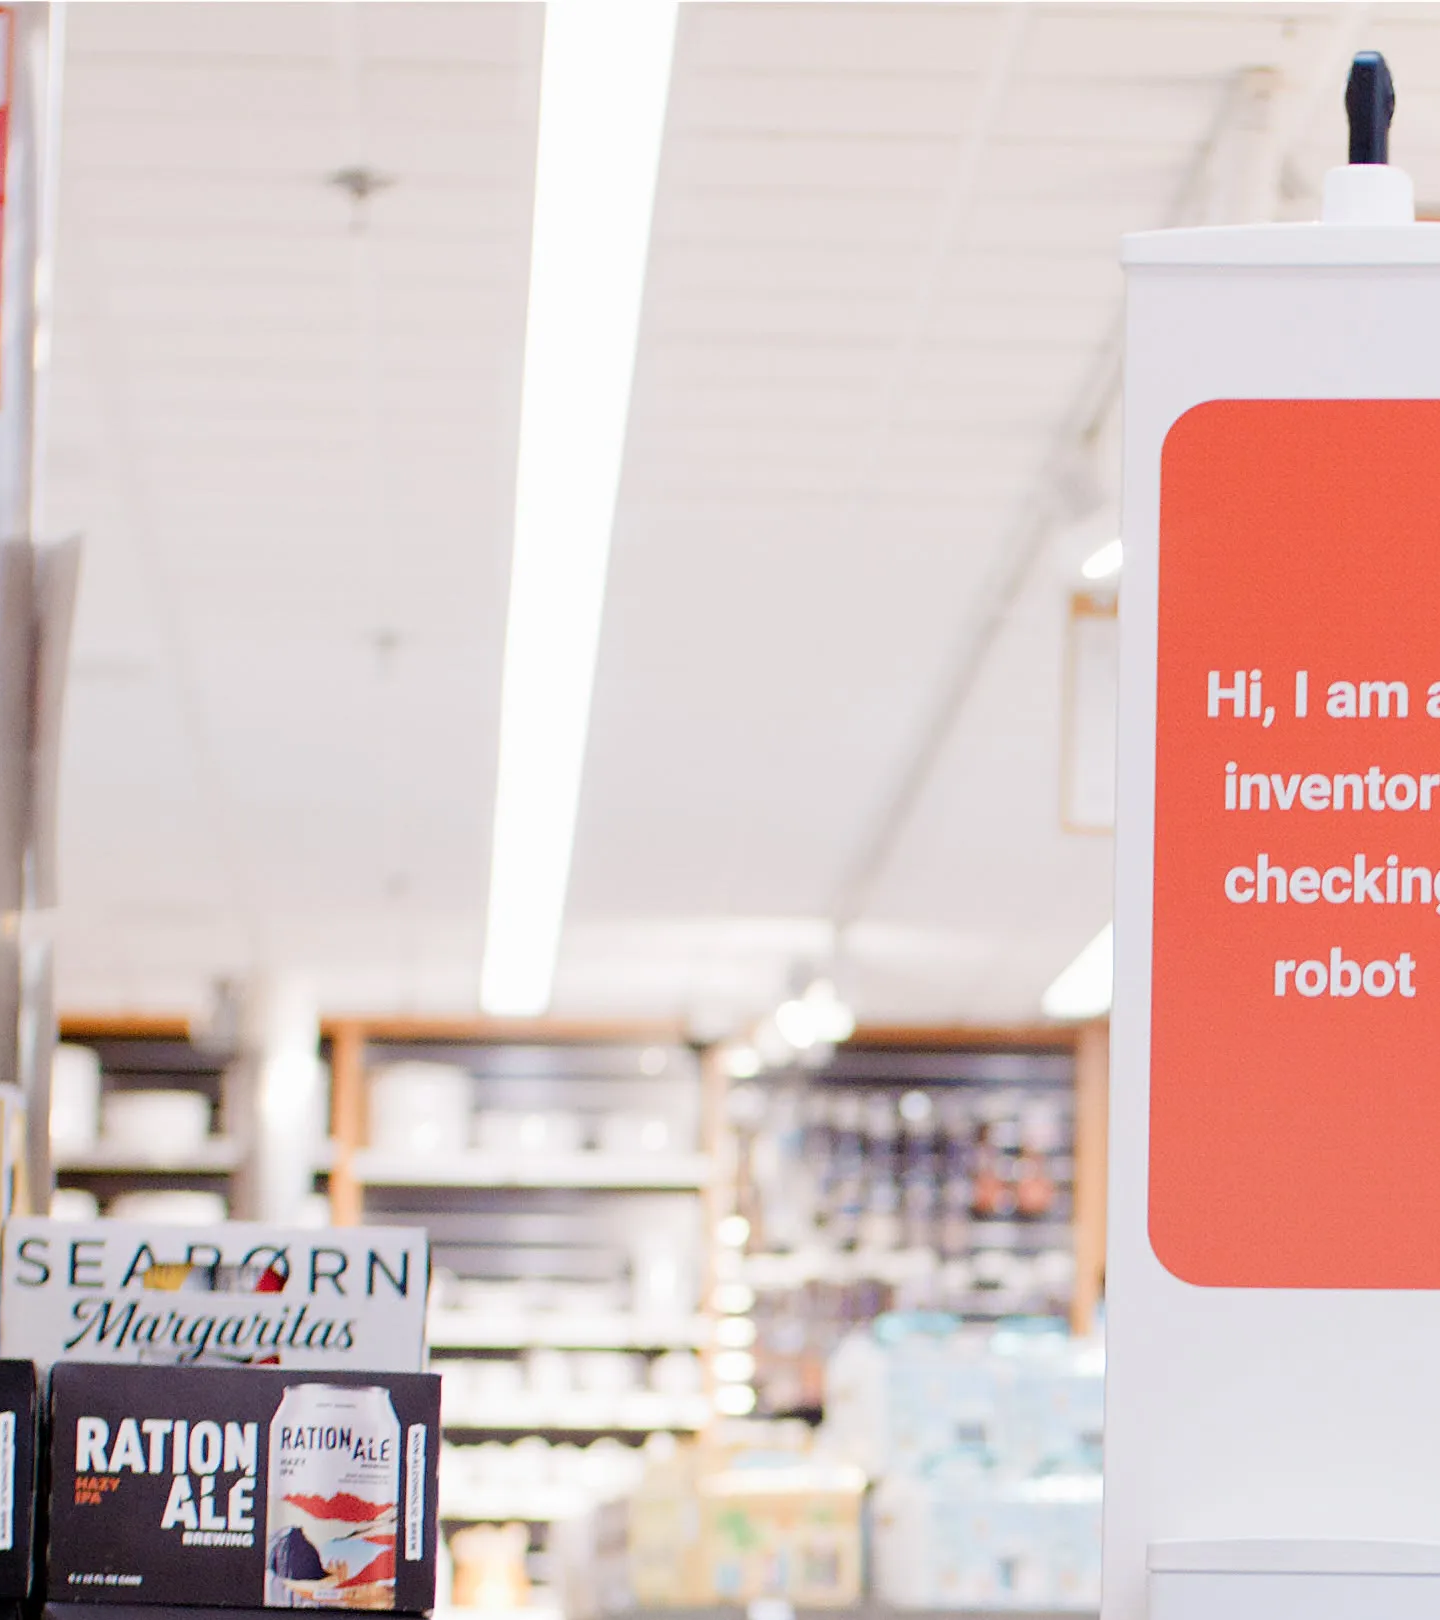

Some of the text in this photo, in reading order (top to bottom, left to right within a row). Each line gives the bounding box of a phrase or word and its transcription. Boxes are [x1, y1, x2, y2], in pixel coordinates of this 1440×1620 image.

[1207, 669, 1276, 728] Hi,
[1295, 670, 1308, 718] I
[1326, 680, 1409, 718] am
[1274, 946, 1417, 998] robot
[64, 1297, 354, 1363] Margaritas
[75, 1416, 258, 1475] RATION
[280, 1426, 353, 1452] RATION
[352, 1436, 391, 1462] ALE
[74, 1475, 121, 1492] HAZY
[74, 1491, 103, 1506] IPA
[160, 1474, 257, 1531] ALE
[181, 1530, 256, 1548] BREWING
